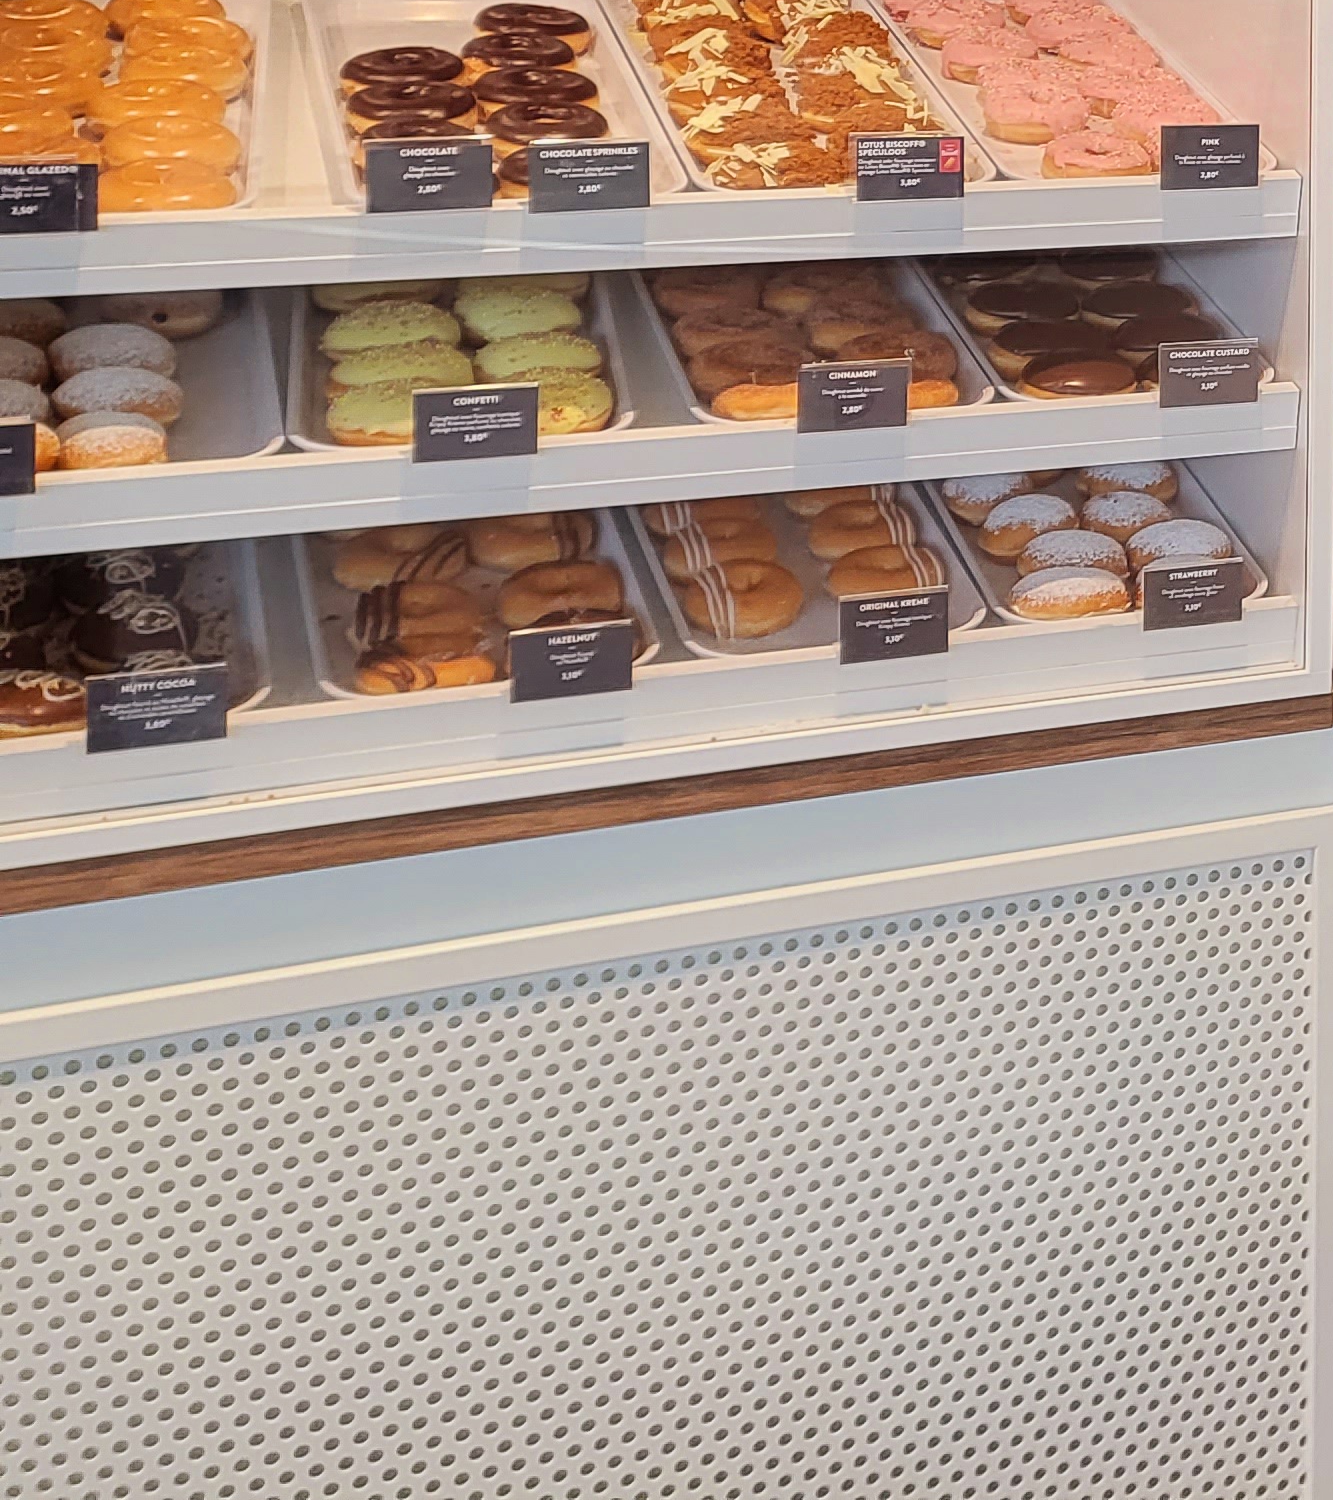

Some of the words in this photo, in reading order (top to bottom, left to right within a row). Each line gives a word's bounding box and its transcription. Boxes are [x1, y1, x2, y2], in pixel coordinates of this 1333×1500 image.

[858, 141, 885, 149] LOTUS
[1201, 138, 1220, 146] PINK
[400, 146, 459, 157] CHOCOLATE
[540, 148, 592, 158] CHOCOLATE
[593, 146, 639, 156] SPRINKLES
[858, 148, 907, 156] SPECULOOS
[1169, 349, 1215, 359] CHOCOLATE
[1216, 348, 1250, 357] CUSTARD
[828, 369, 877, 380] CINNAMON
[452, 395, 499, 406] CONFETTI
[1168, 569, 1218, 581] STRAWBERRY
[859, 601, 900, 612] ORIGINAL
[900, 597, 930, 607] KREME
[547, 631, 599, 646] HAZELNUT
[120, 682, 155, 694] NUTTY
[156, 677, 197, 690] COCOA
